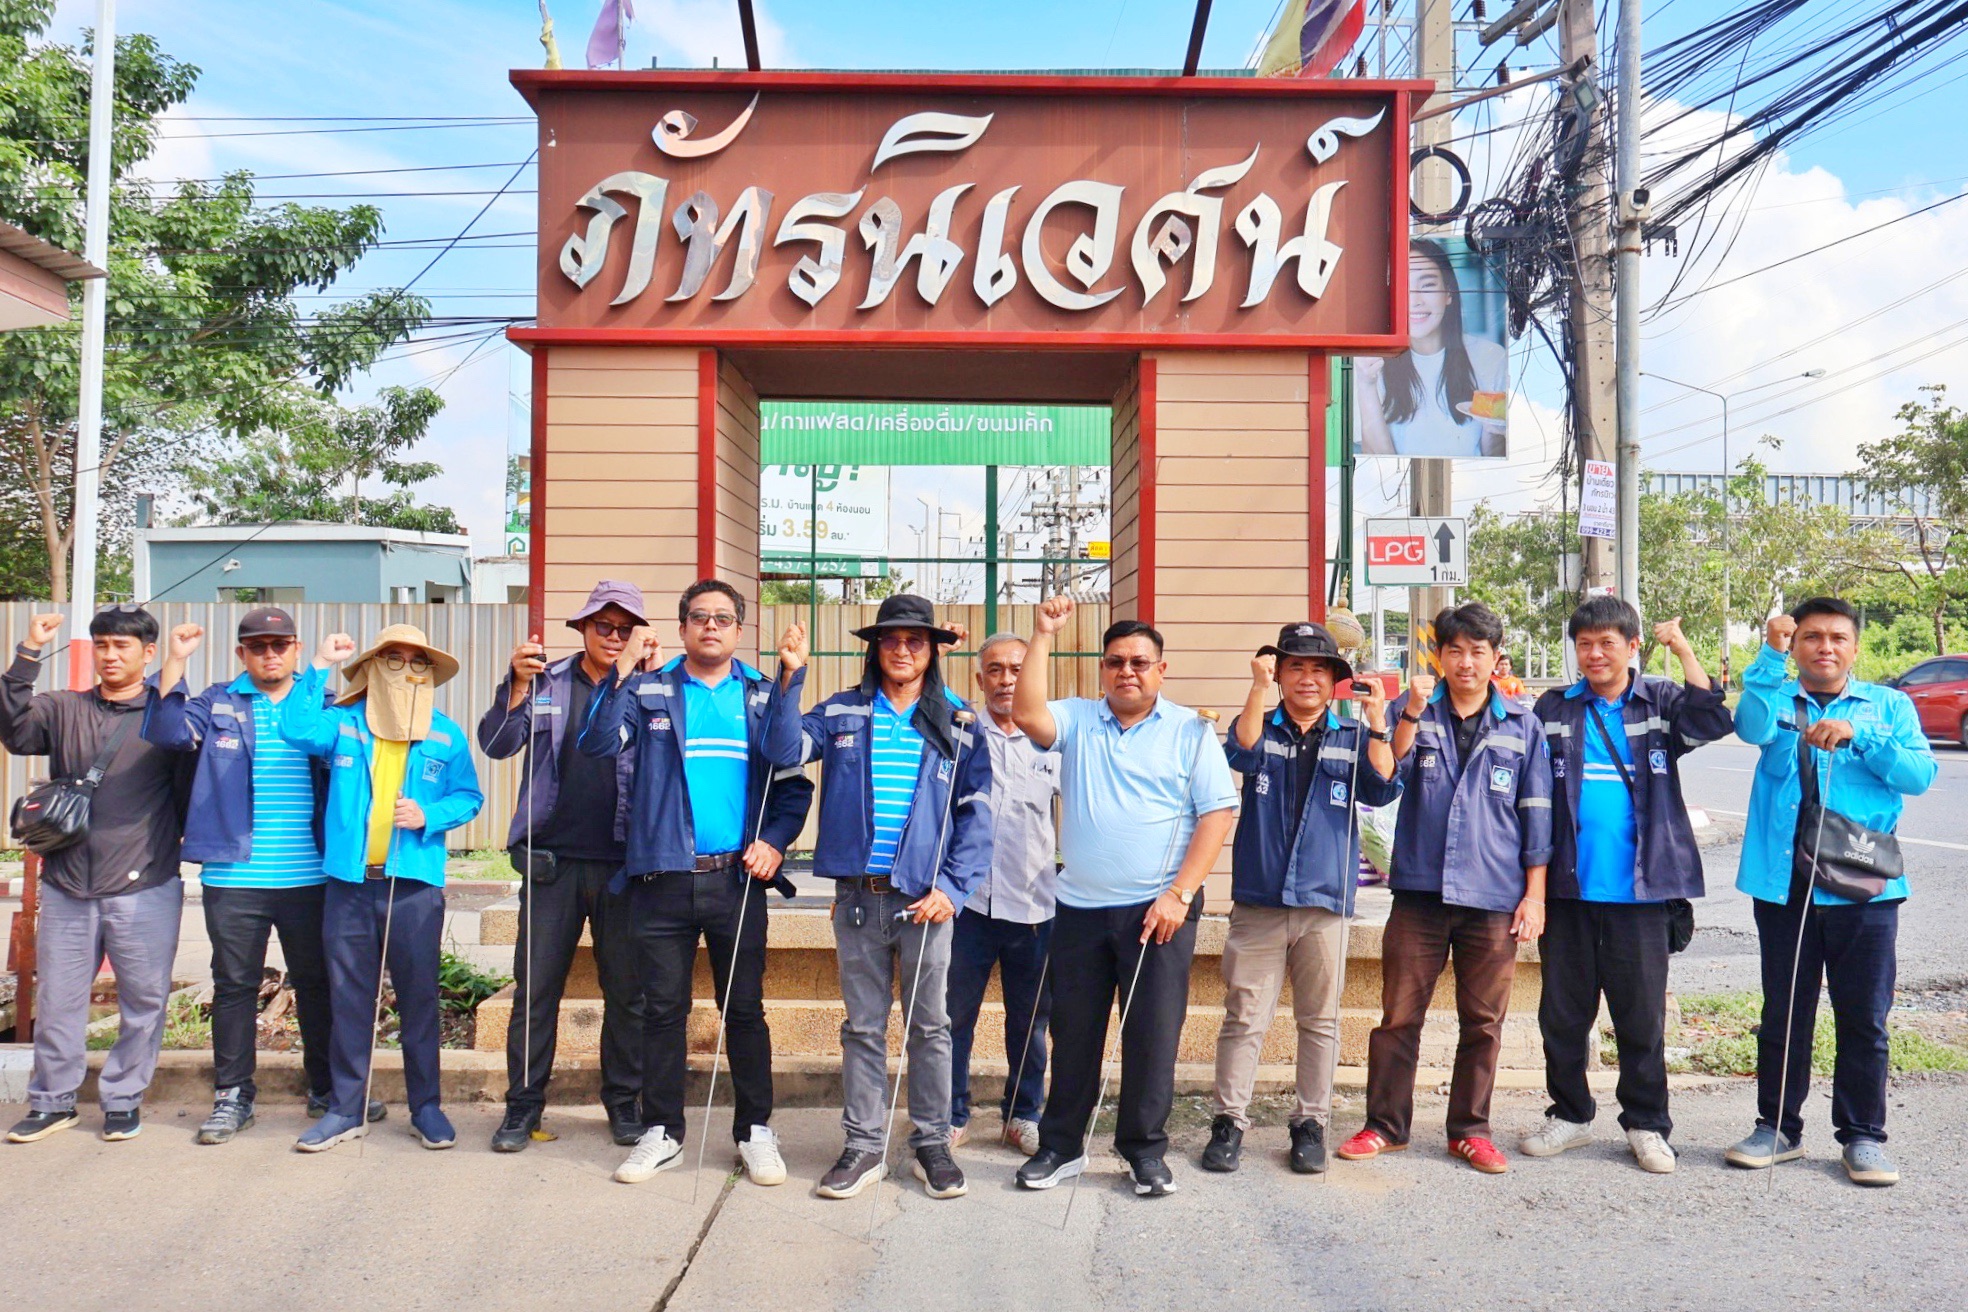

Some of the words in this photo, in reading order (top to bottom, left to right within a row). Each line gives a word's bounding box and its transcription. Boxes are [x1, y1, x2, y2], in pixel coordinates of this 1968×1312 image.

[559, 91, 1387, 310] ภัทรนิเวศน์
[1588, 463, 1609, 475] ขาย
[787, 500, 823, 511] บ้านแด
[826, 501, 834, 512] 4
[836, 503, 871, 515] ห้องนอน
[782, 518, 829, 539] 3.59
[1369, 541, 1424, 563] LPG
[1430, 565, 1437, 582] 1
[1441, 570, 1461, 582] กม.
[648, 722, 671, 731] 1662
[1843, 850, 1874, 865] adidas
